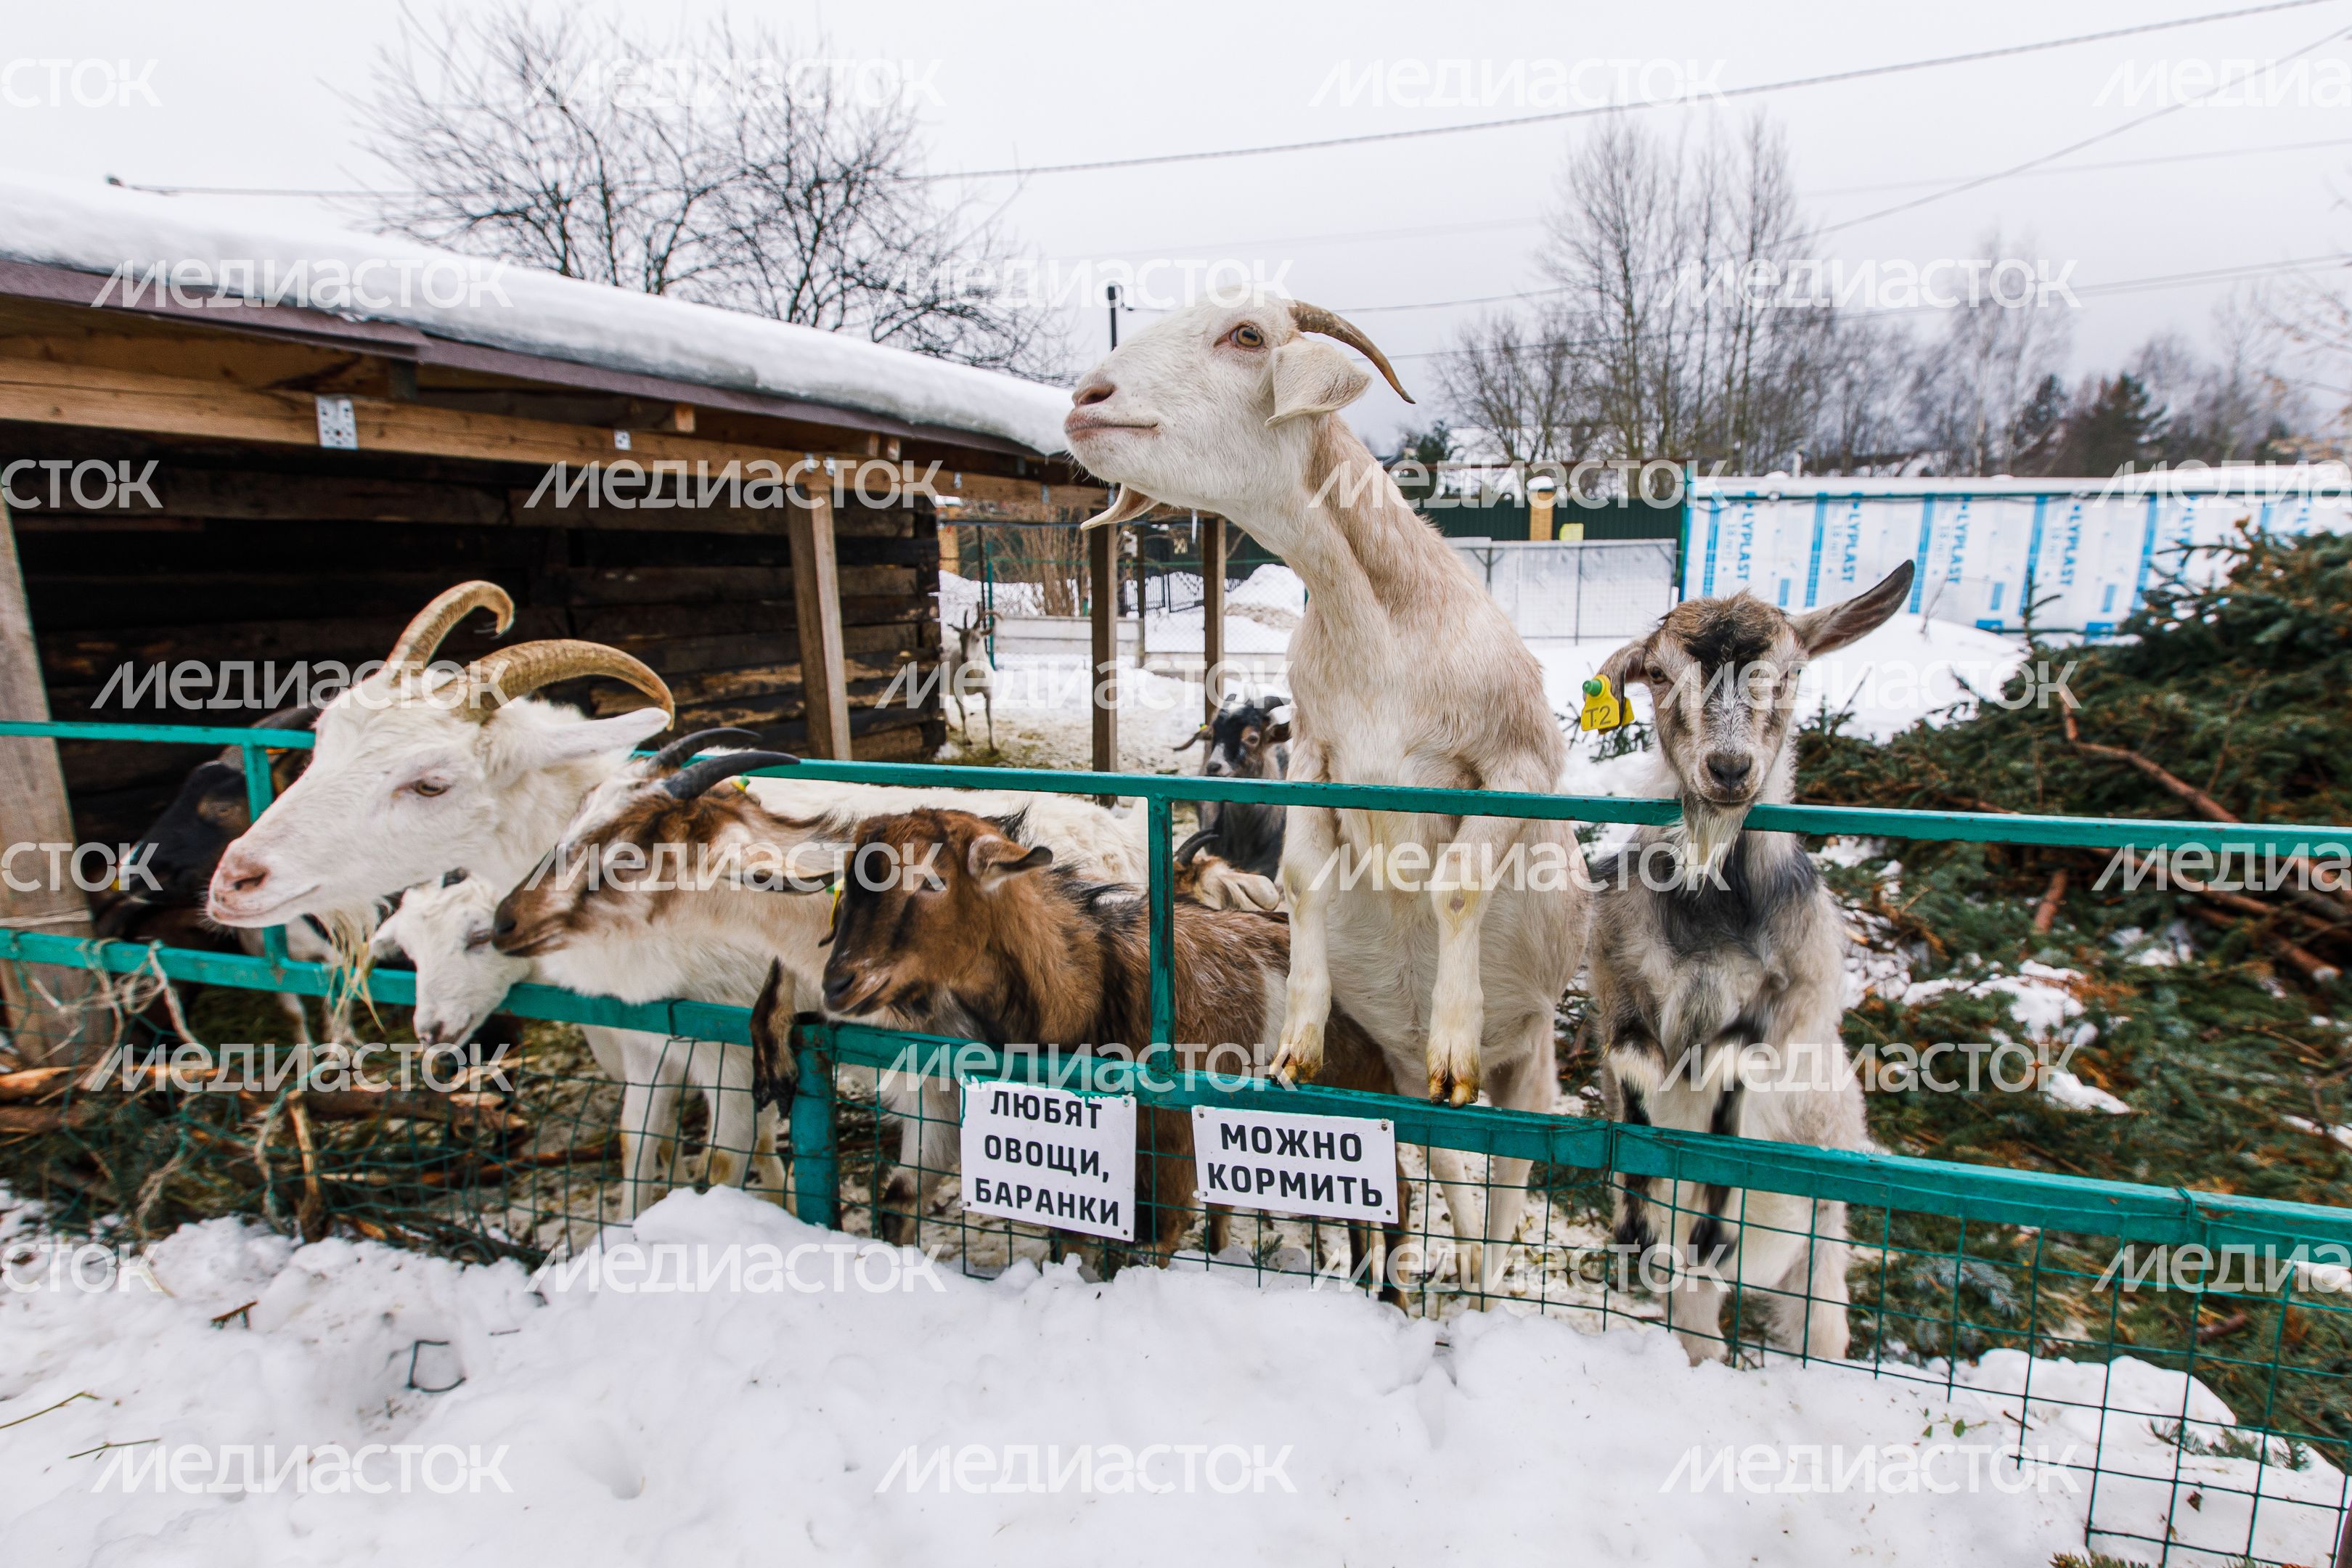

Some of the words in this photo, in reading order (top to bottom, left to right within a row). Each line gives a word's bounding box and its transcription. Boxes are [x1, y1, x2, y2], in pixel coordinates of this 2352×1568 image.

[990, 1090, 1102, 1129] ЛЮБЯТ
[984, 1135, 1109, 1183] ОВОЩИ,
[1220, 1123, 1362, 1161] МОЖНО
[976, 1177, 1119, 1227] БАРАНКИ
[1208, 1163, 1383, 1206] КОРМИТЬ
